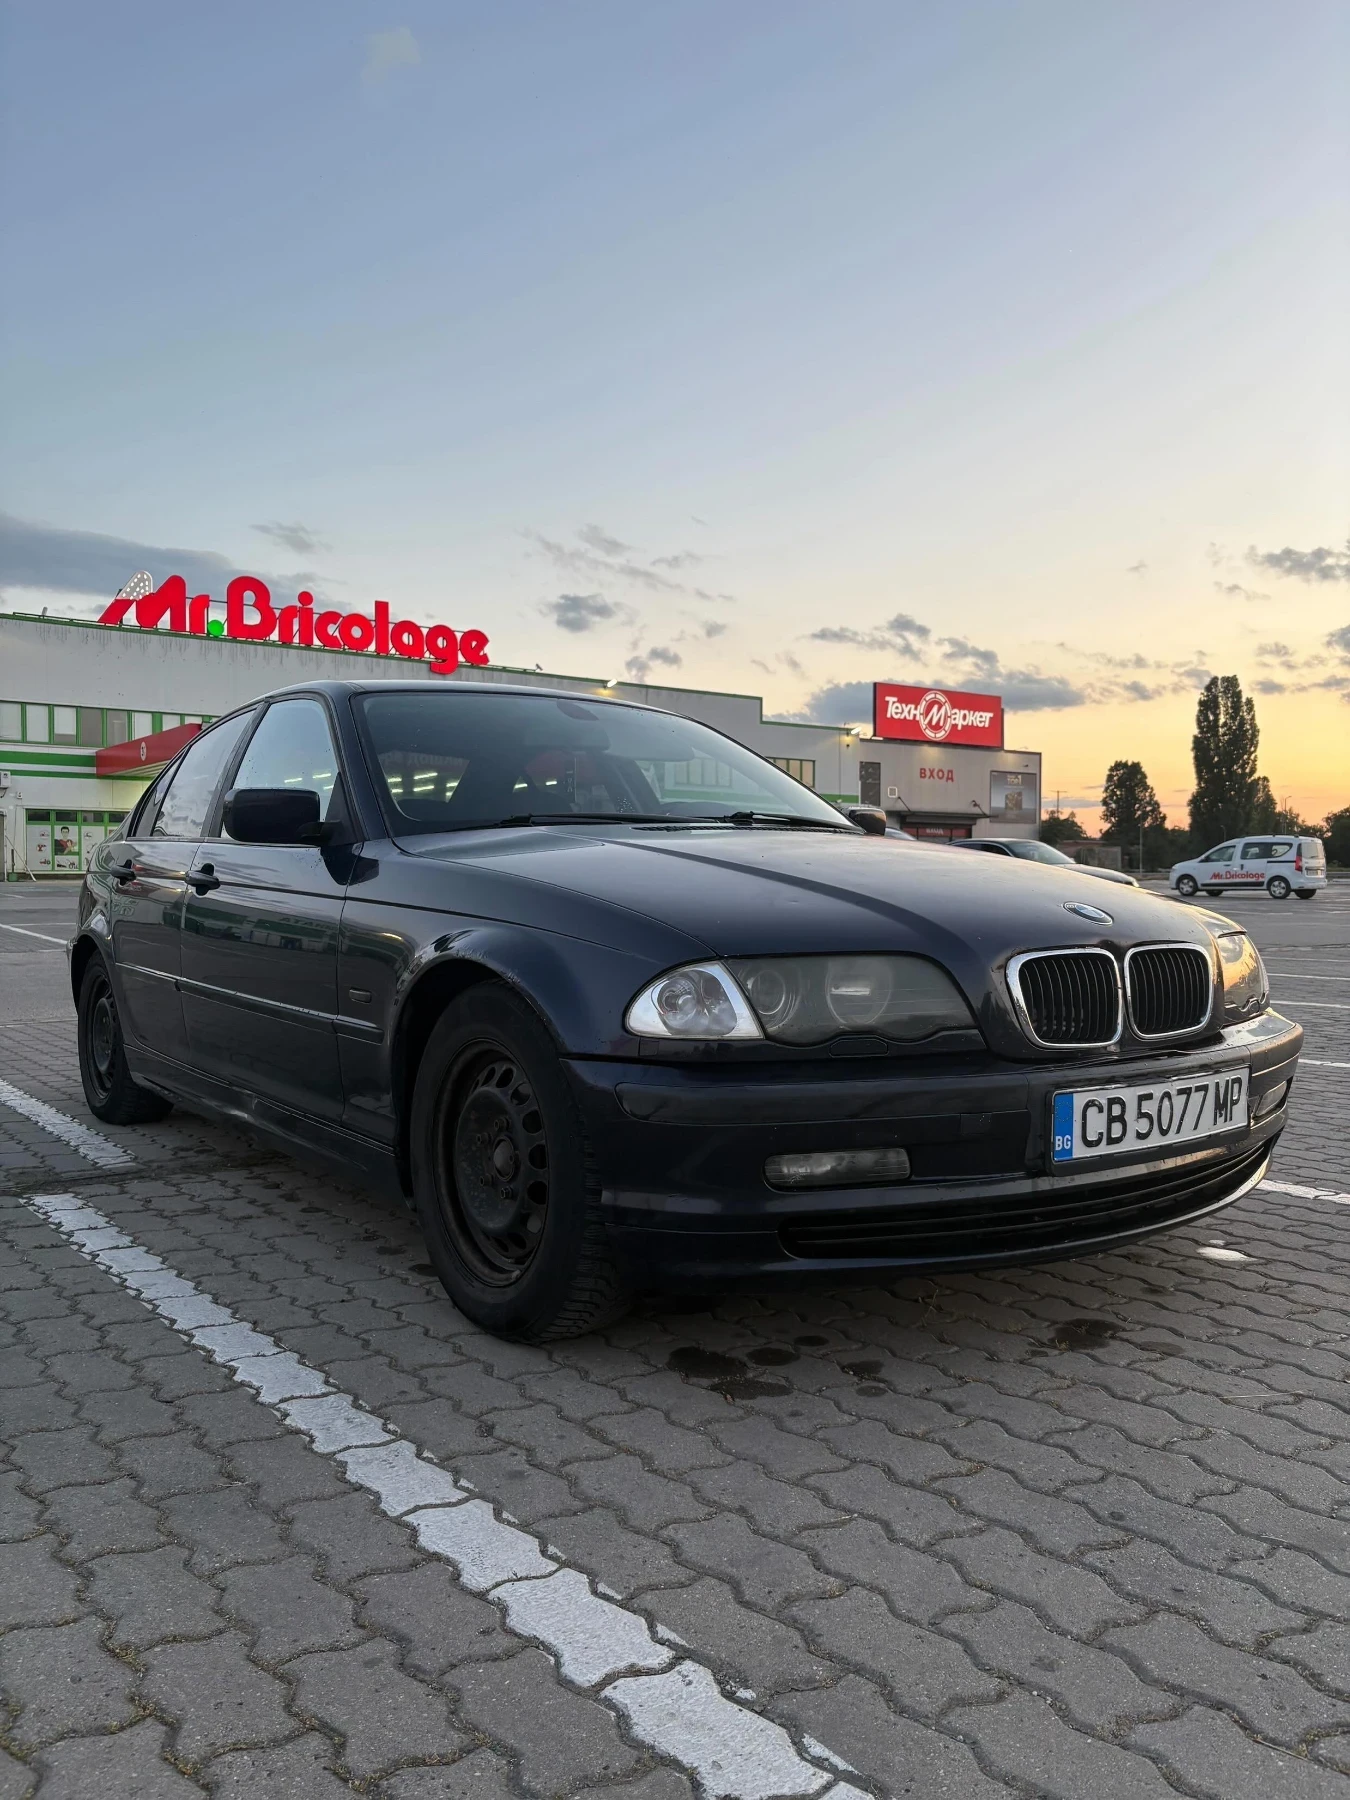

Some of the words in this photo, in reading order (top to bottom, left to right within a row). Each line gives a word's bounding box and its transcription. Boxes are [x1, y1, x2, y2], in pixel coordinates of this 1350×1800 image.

[919, 768, 955, 783] ВХОД
[1081, 1096, 1127, 1148] CB
[1135, 1082, 1209, 1141] 5077
[1213, 1075, 1242, 1126] MP
[1055, 1135, 1071, 1150] BG
